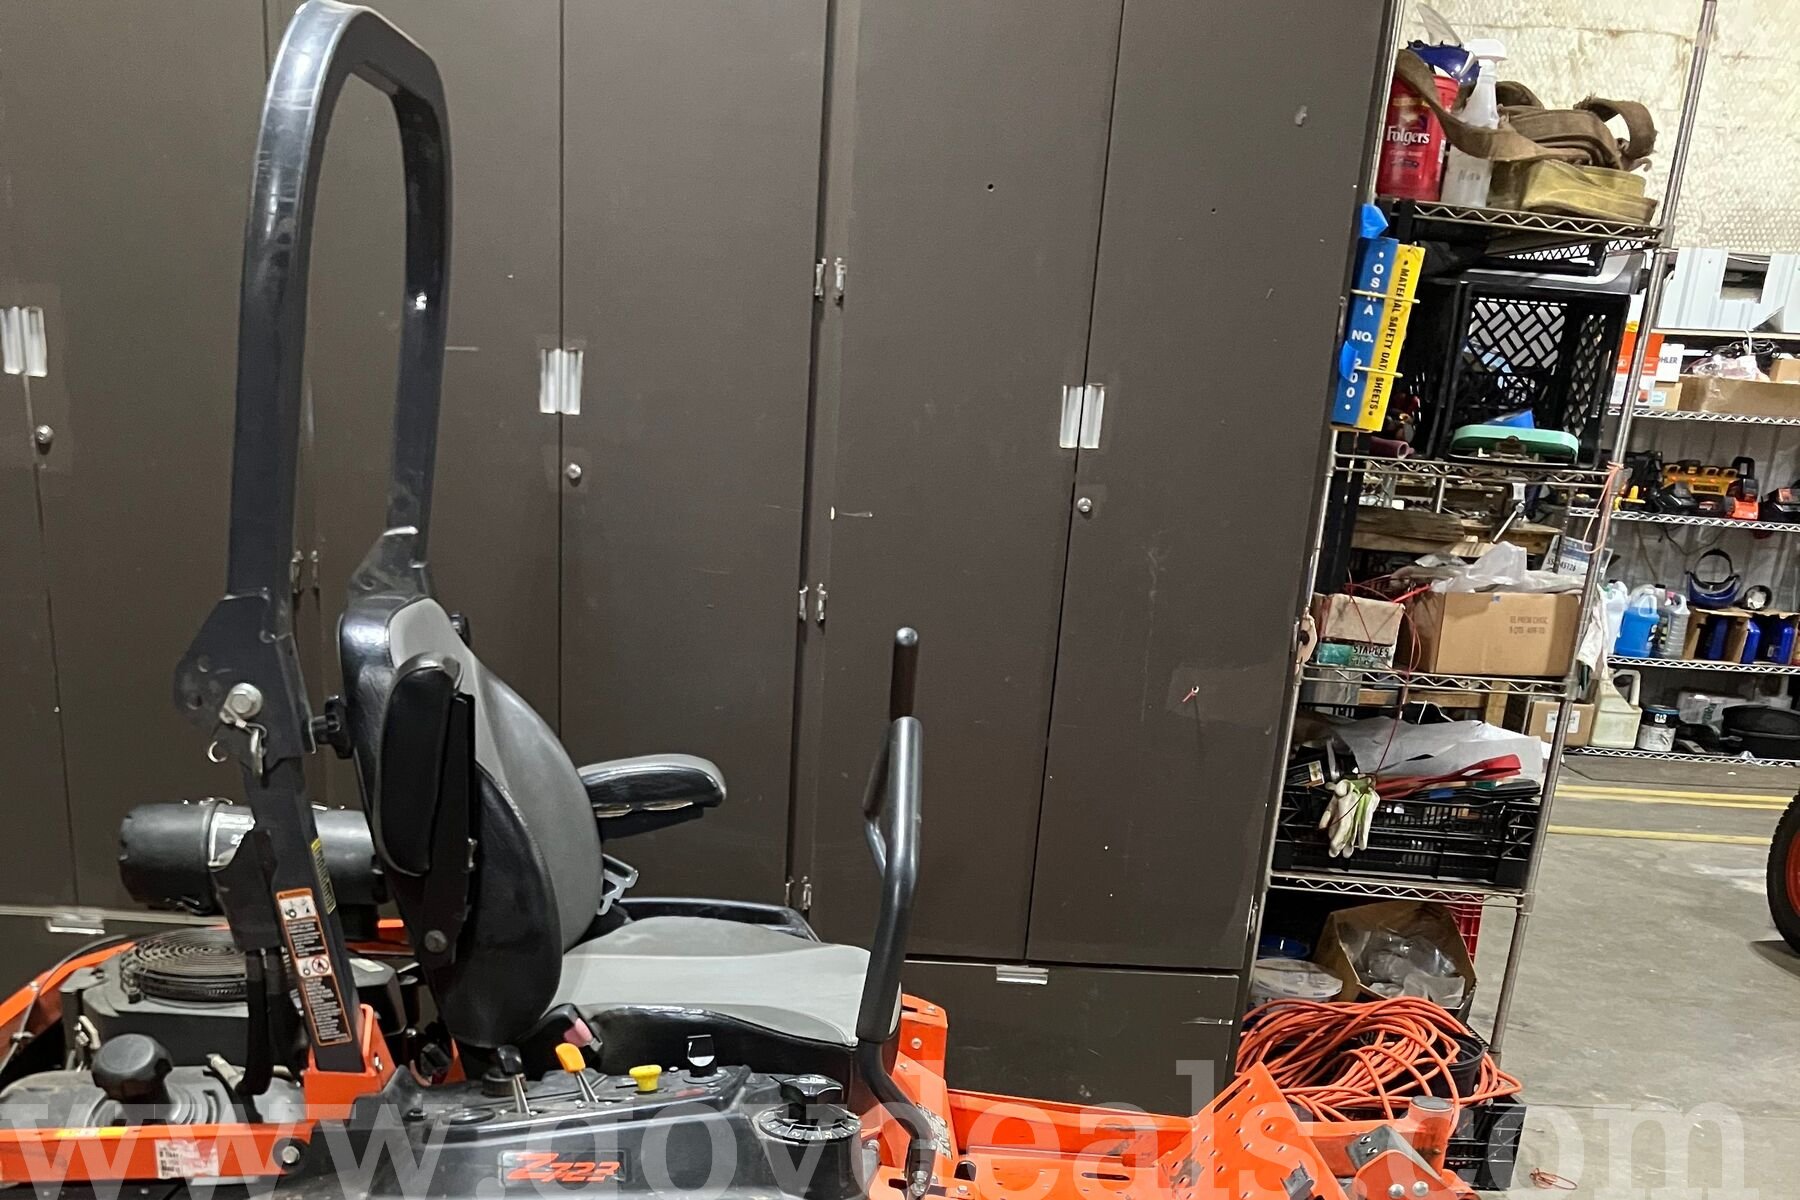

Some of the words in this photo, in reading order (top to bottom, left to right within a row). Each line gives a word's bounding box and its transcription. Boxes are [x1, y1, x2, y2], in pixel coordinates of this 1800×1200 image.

[1387, 126, 1430, 145] Folgers
[1352, 330, 1374, 343] NO.
[1384, 316, 1398, 349] SAFETY
[1378, 352, 1390, 371] DAT
[1369, 377, 1384, 409] SHEETS
[507, 1152, 621, 1183] Z723
